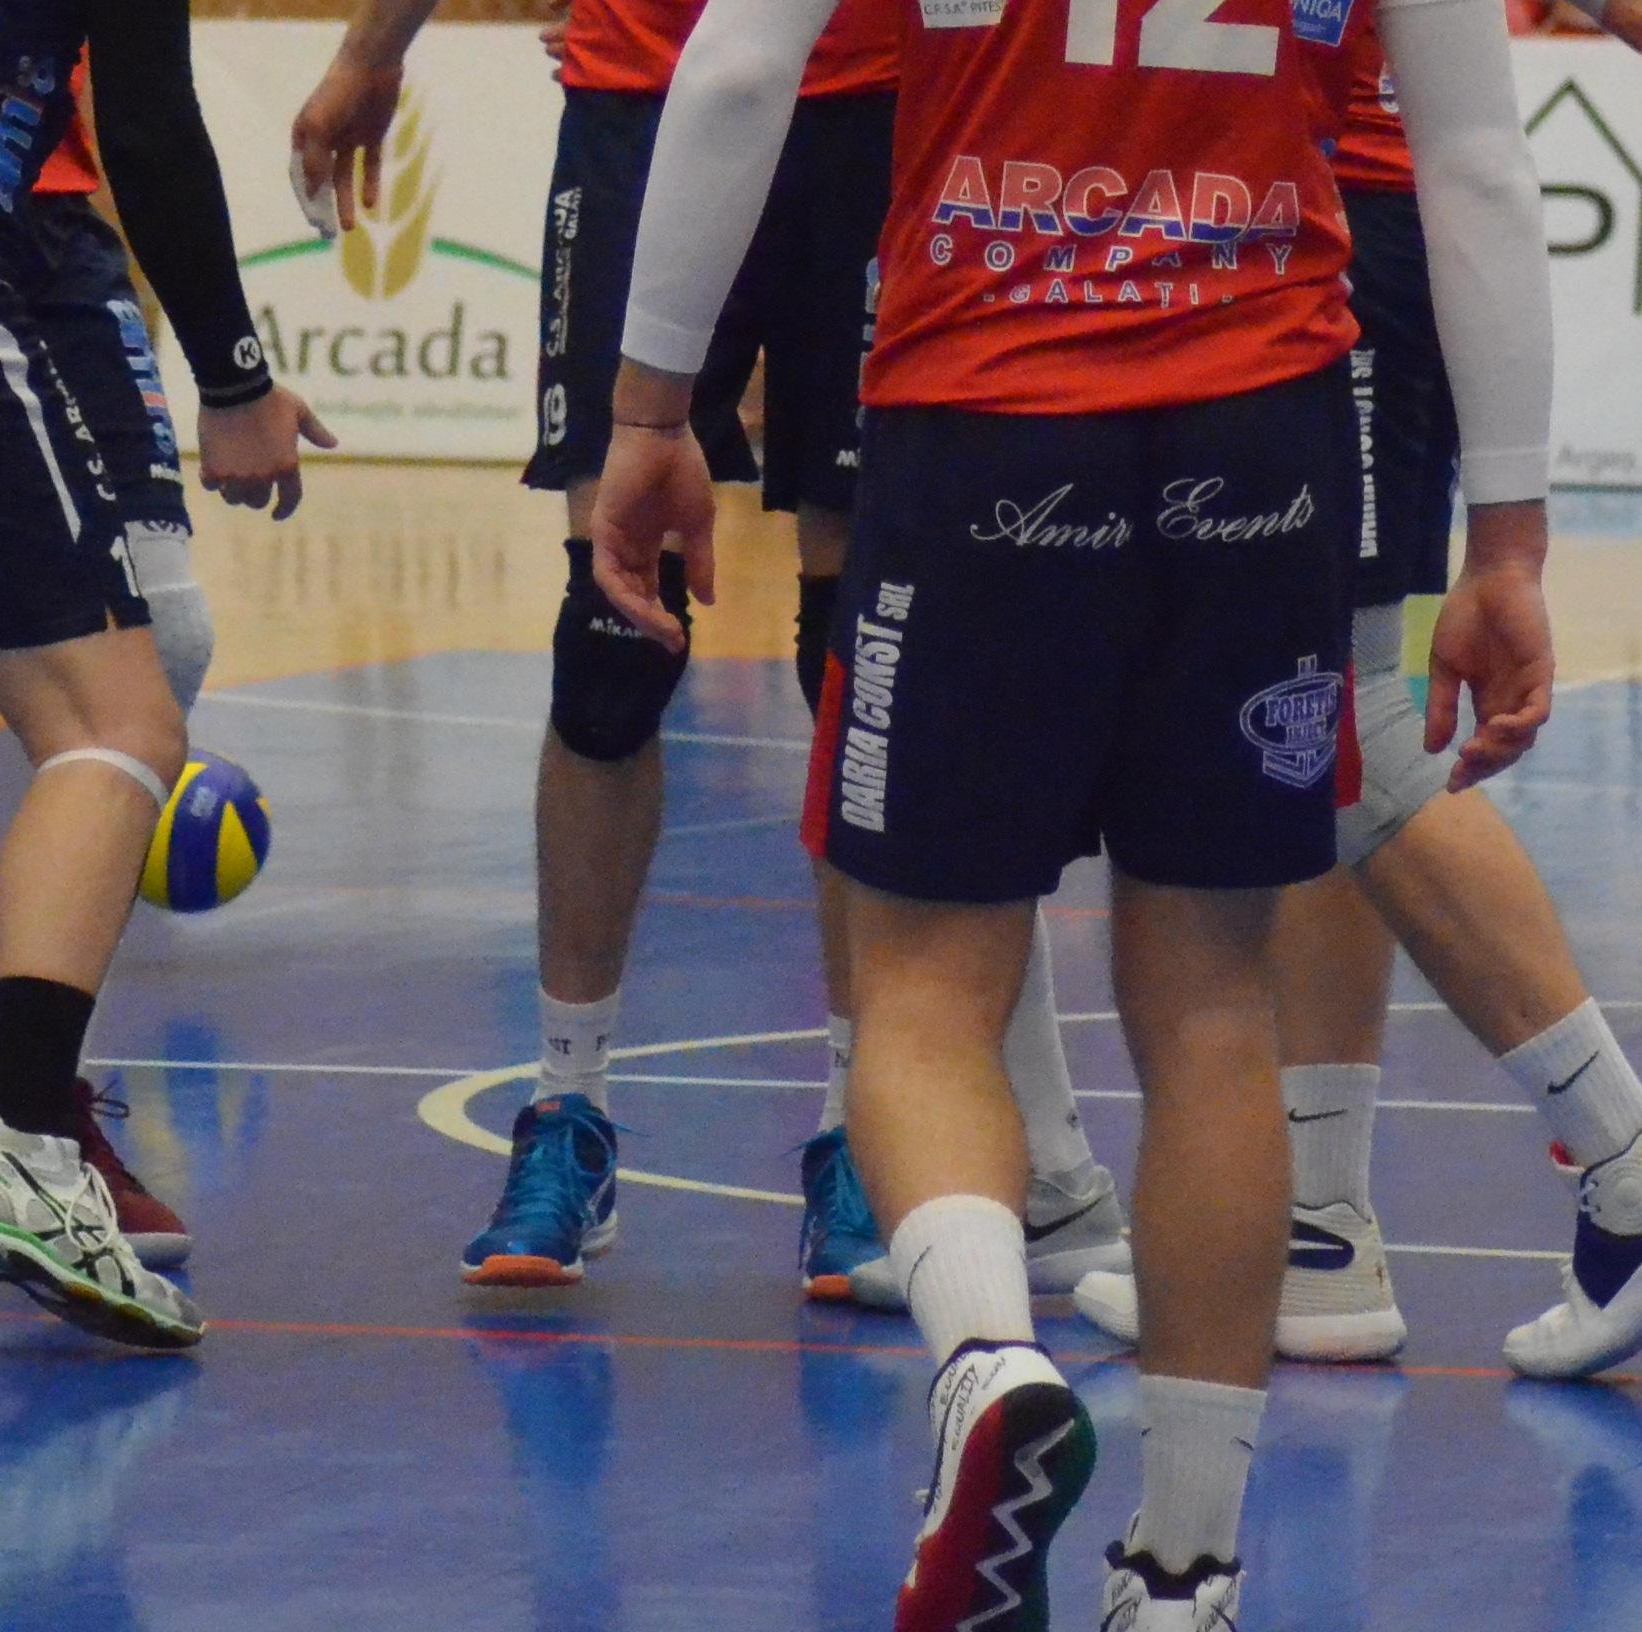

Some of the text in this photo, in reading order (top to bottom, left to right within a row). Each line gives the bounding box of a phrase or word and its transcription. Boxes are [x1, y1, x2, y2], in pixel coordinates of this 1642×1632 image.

[932, 155, 1300, 244] ARCADA
[930, 233, 1293, 276] COMPANY
[255, 302, 510, 381] Arcada
[1156, 477, 1315, 542] Events
[841, 580, 916, 834] DARIA CONST SRL
